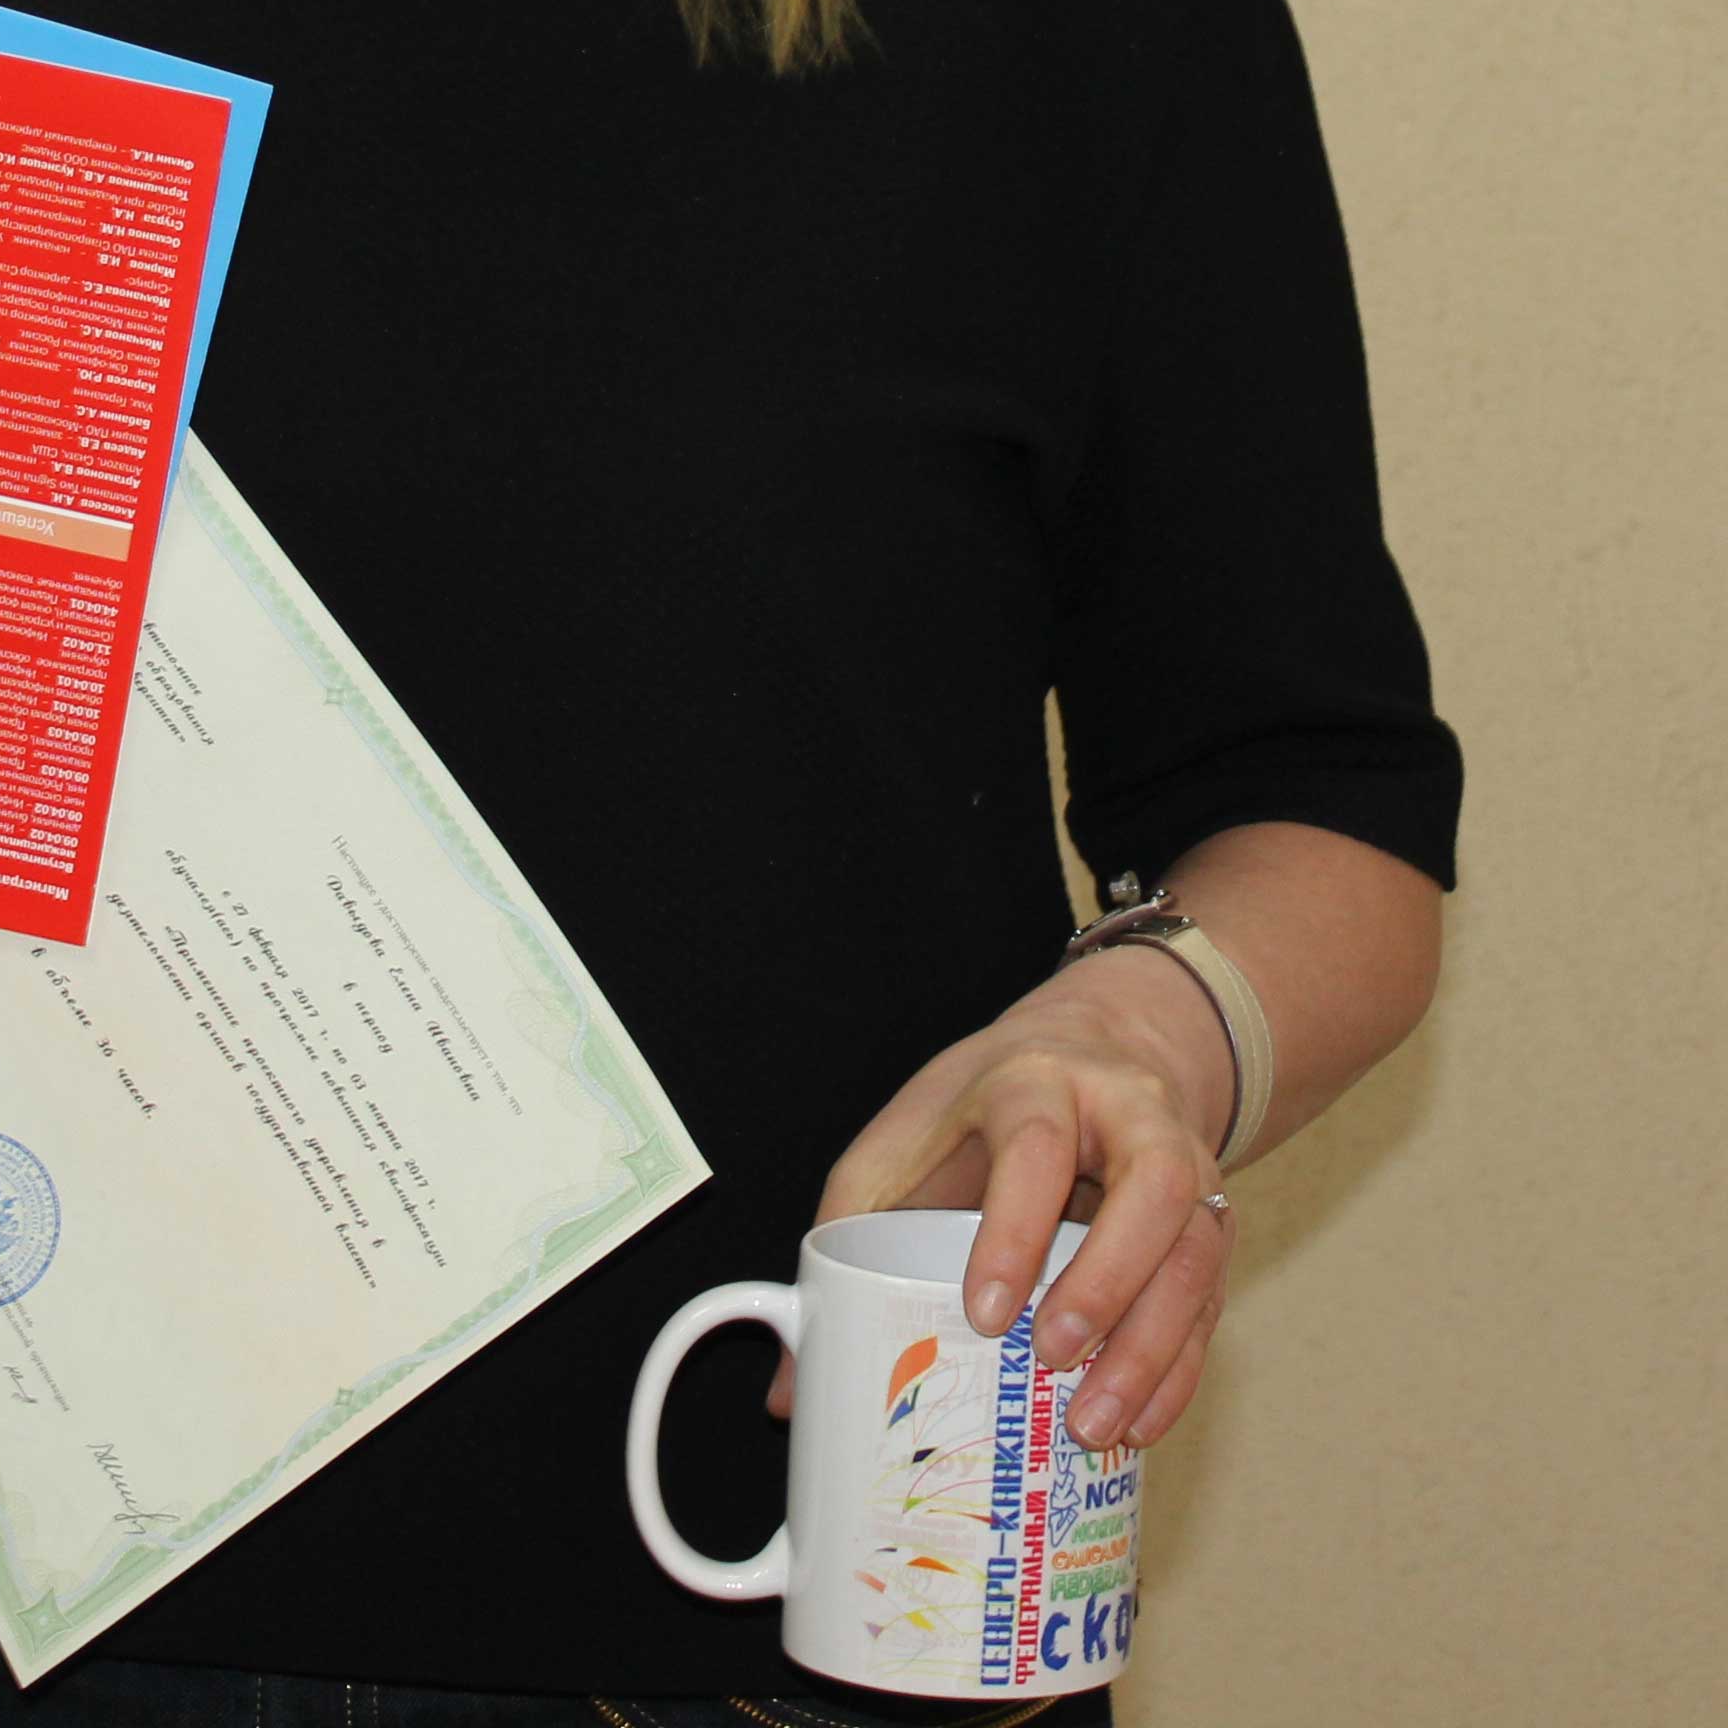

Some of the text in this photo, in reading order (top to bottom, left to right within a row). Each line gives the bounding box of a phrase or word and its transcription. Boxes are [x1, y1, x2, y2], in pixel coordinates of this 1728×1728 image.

[129, 147, 154, 163] И.А.
[152, 153, 195, 171] Филин
[17, 156, 75, 178] Кузнецов
[77, 167, 106, 184] А.В.,
[106, 174, 189, 202] Тертышников
[111, 206, 135, 222] Н.А.
[141, 212, 185, 232] Стурза
[98, 221, 126, 237] Н.М.
[126, 227, 182, 249] Османов
[96, 252, 121, 267] И.В.
[128, 258, 176, 279] Марков
[80, 279, 104, 295] Е.С.
[102, 284, 171, 309] Молчанова
[79, 323, 104, 338] А.С.
[102, 328, 164, 352] Молчанов
[76, 367, 103, 383] Р.Ю.
[104, 373, 157, 395] Карасев
[73, 403, 98, 419] А.С.
[96, 409, 151, 431] Бабанин
[77, 435, 101, 451] Е.В.
[100, 440, 147, 460] Авдеев
[50, 460, 74, 476] В.А.
[74, 465, 142, 490] Артамонов
[50, 491, 75, 506] А.И.
[79, 497, 136, 519] Алексеев
[69, 597, 119, 618] 44.04.01
[60, 635, 113, 657] 11.04.02
[141, 616, 203, 696] втономное
[56, 674, 106, 694] 10.04.01
[52, 699, 101, 720] 10.04.01
[46, 725, 97, 746] 09.04.03
[39, 764, 90, 784] 09.04.03
[33, 802, 84, 823] 09.04.02
[28, 827, 79, 848] 09.04.02
[96, 1040, 115, 1058] 36
[231, 902, 249, 917] 27
[247, 926, 289, 979] февраля
[290, 987, 320, 1018] 2017
[349, 1073, 367, 1091] 03
[403, 1158, 429, 1188] 2017
[1014, 1489, 1048, 1685] ФЕДЕРАЛЬНЫЙ
